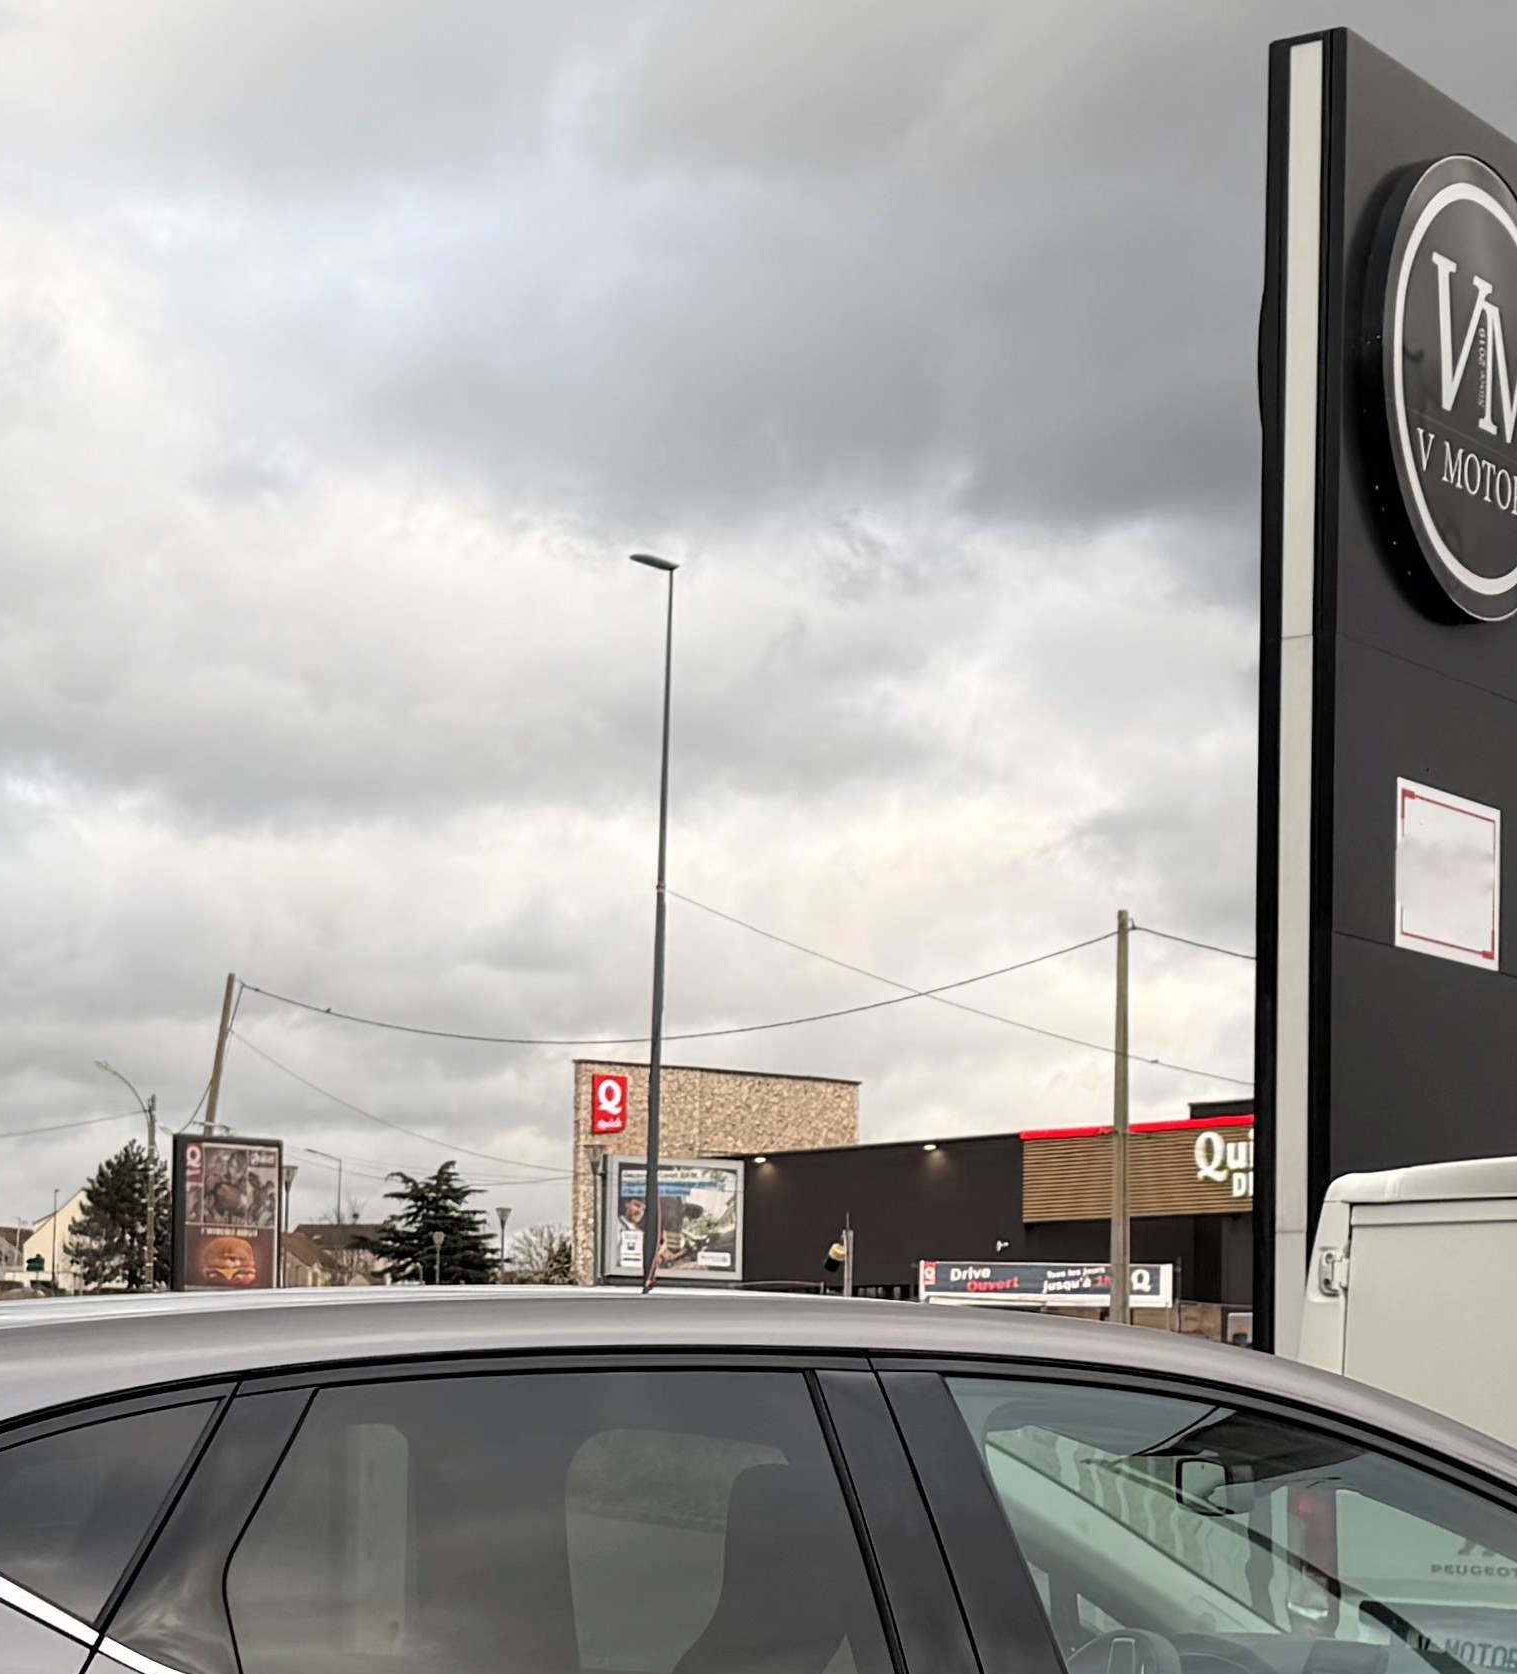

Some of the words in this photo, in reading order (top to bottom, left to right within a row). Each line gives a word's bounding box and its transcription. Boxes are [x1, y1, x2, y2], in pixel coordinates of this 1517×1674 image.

[1416, 427, 1437, 472] V
[598, 1079, 622, 1115] Q
[597, 1117, 623, 1130] Quick
[950, 1266, 991, 1282] Drive
[966, 1276, 1020, 1293] Ouvert
